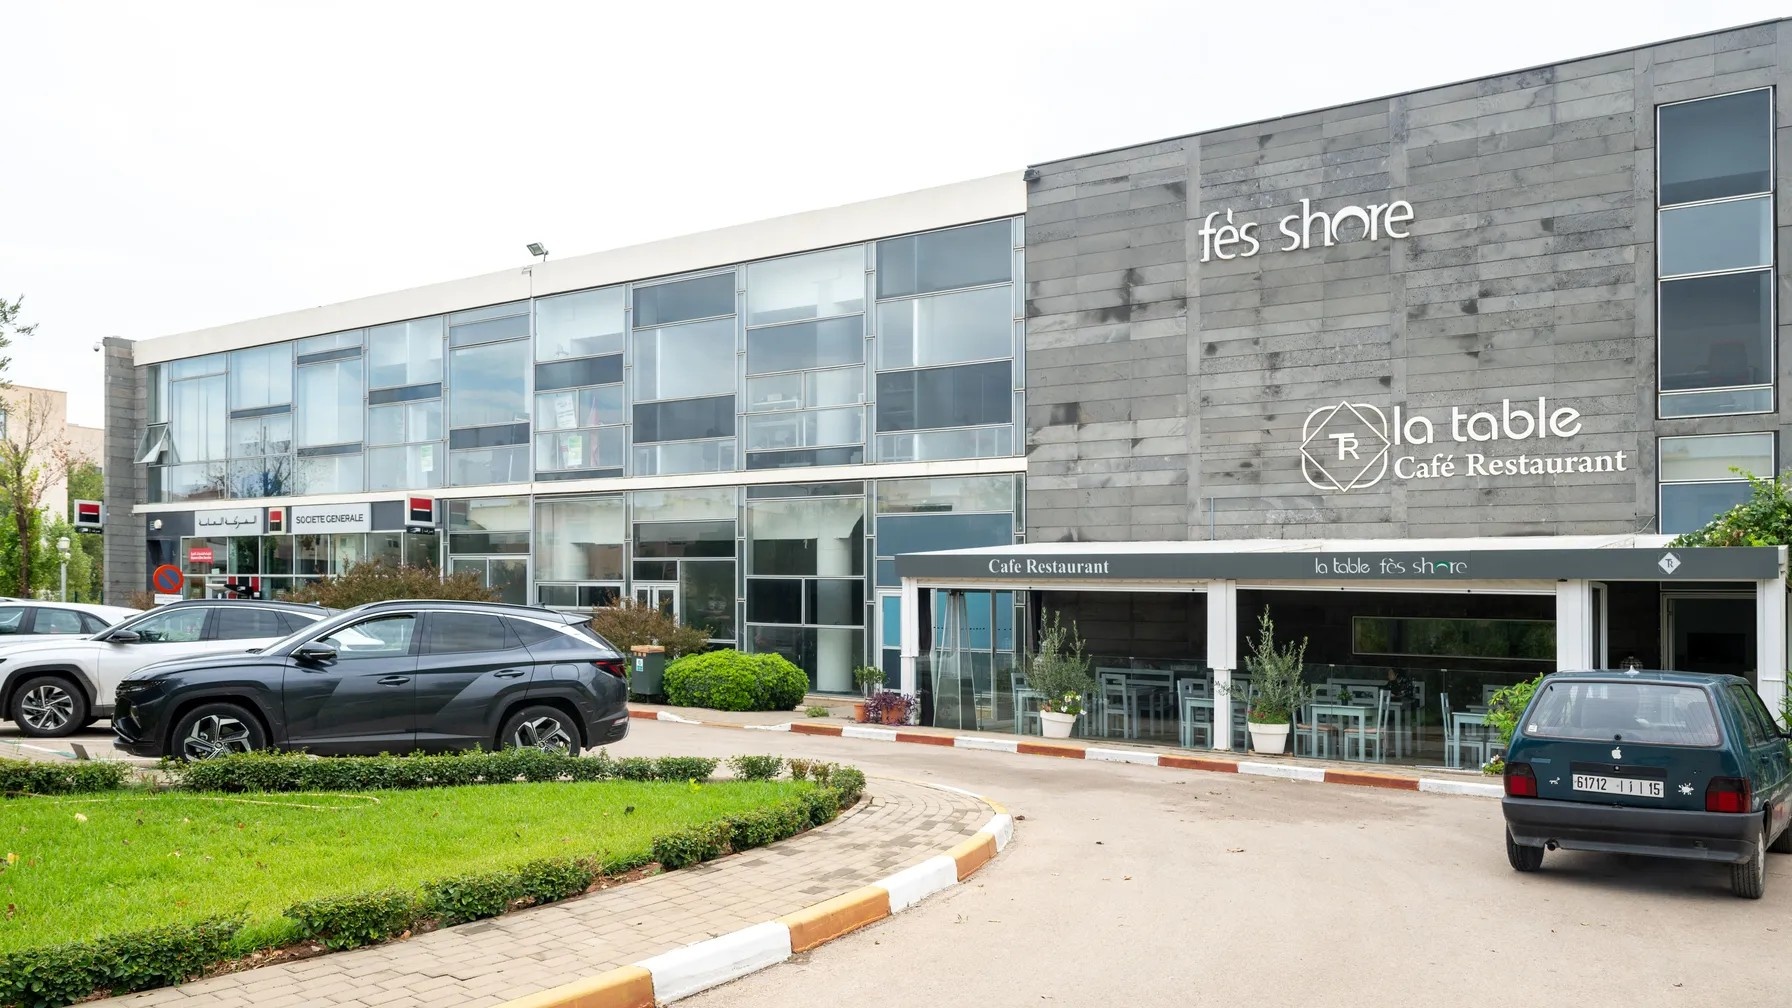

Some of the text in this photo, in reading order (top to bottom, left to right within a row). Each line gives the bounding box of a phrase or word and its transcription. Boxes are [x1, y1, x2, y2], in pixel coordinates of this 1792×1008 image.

[1198, 198, 1415, 262] fès shore
[1394, 396, 1582, 445] la table
[1394, 449, 1627, 480] Café Restaurant
[295, 513, 364, 524] SOCIETE GENERALE
[988, 558, 1109, 574] Cafe Restaurant
[1315, 557, 1468, 574] la table fès shore
[1576, 775, 1607, 791] 61712
[1648, 782, 1660, 796] 15
